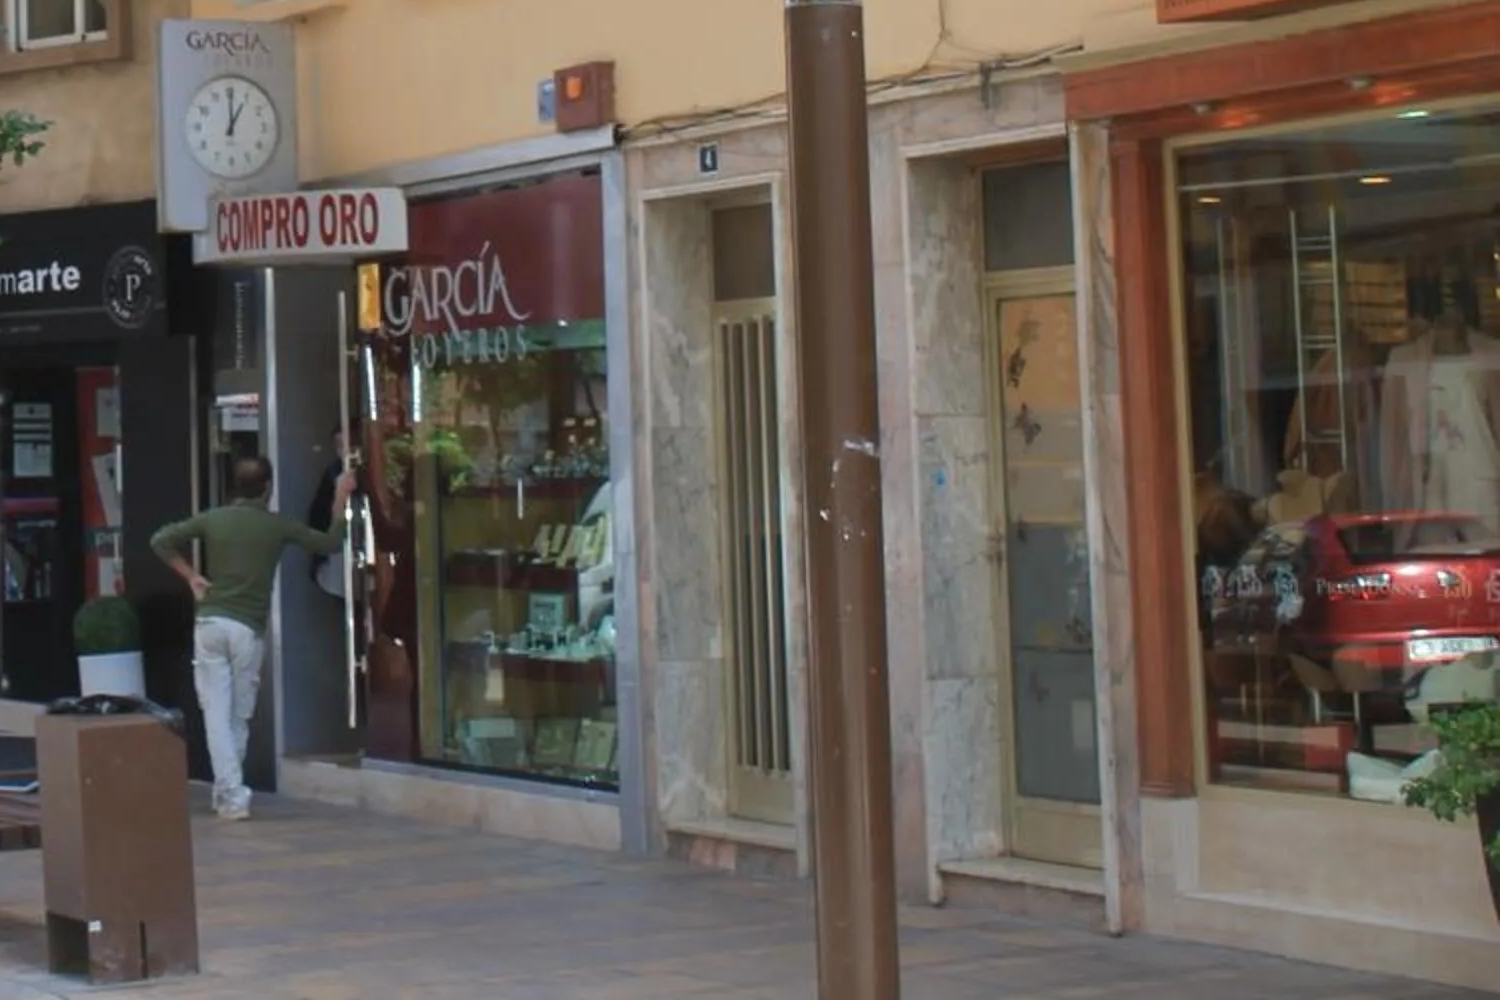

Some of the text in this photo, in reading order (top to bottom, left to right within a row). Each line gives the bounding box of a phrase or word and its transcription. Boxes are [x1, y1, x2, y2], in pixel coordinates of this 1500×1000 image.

[186, 29, 272, 56] GARCÍA
[217, 192, 379, 253] COMPRO ORO
[383, 241, 532, 341] GARCÍA
